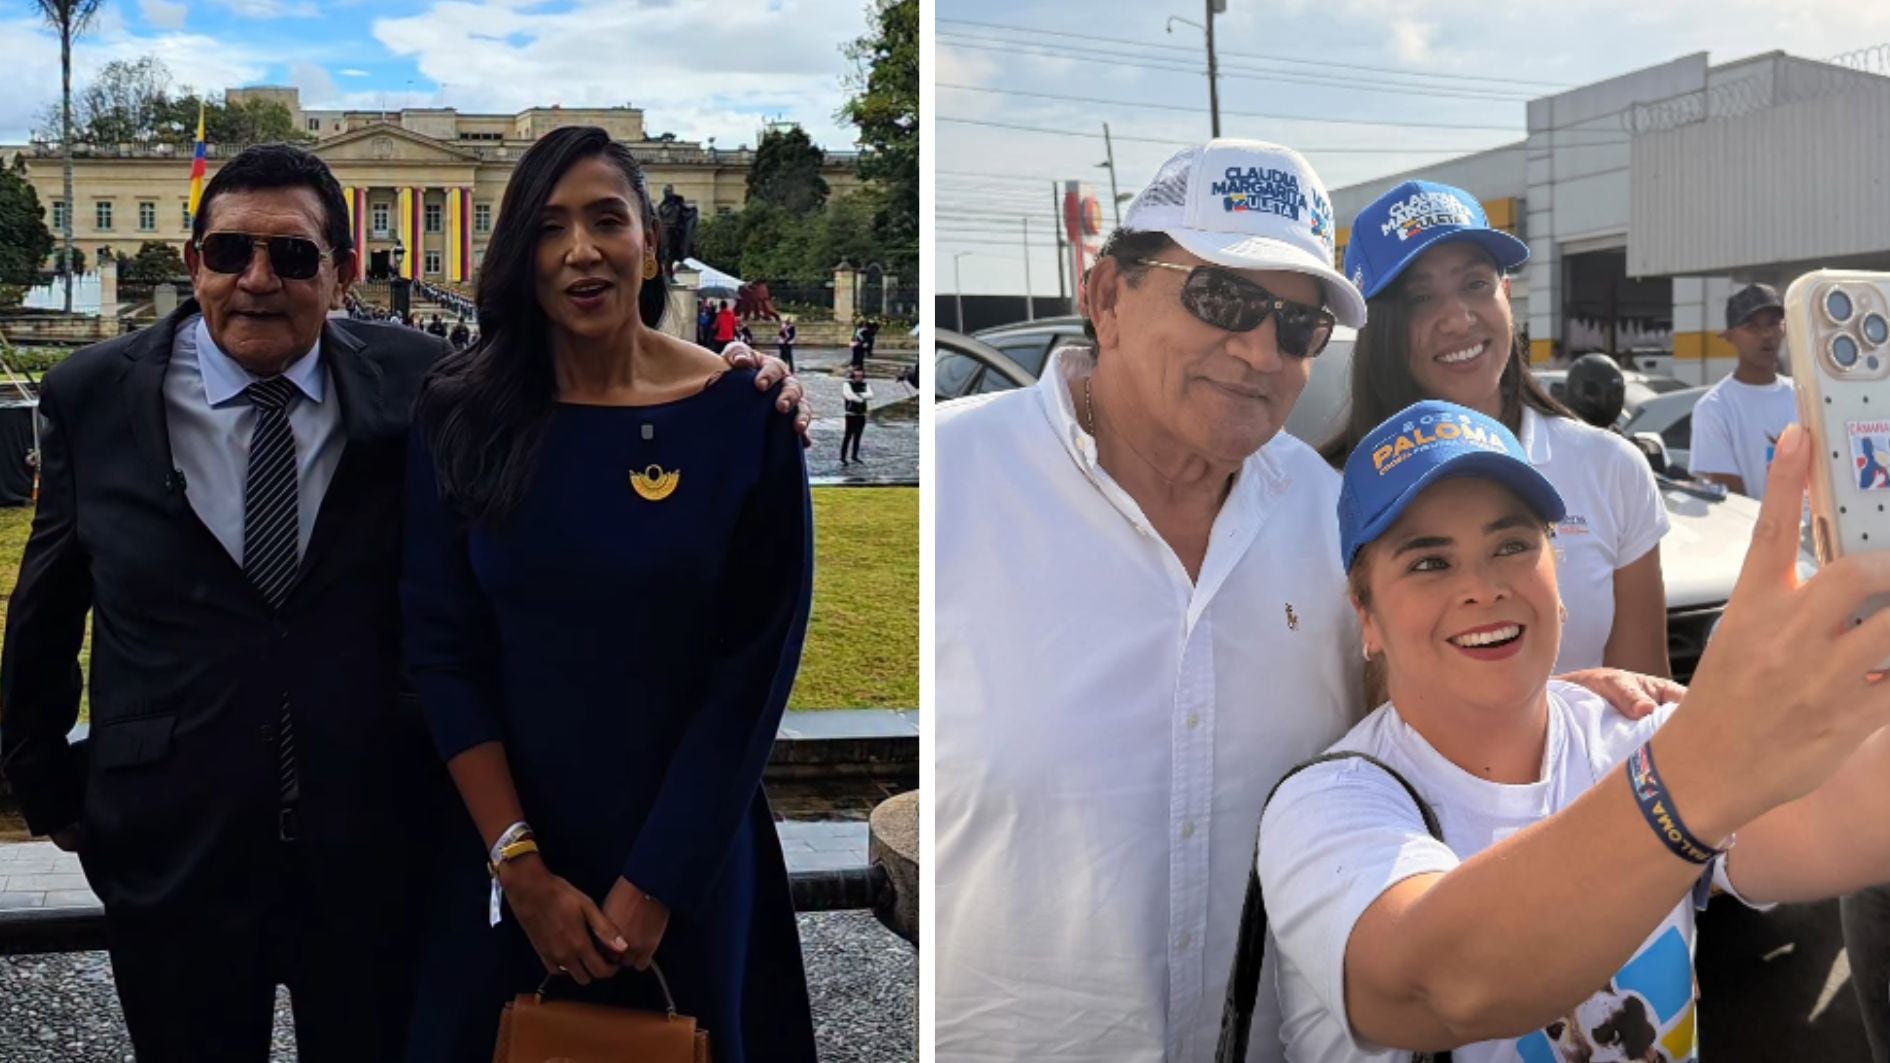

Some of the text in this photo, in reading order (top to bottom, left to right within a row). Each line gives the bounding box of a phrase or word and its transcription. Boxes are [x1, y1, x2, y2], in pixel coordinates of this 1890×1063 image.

[1212, 181, 1308, 211] MARGARITA
[1225, 167, 1298, 191] CLAUDIA
[1372, 422, 1508, 469] PALOMA
[1651, 800, 1709, 860] PALOMA
